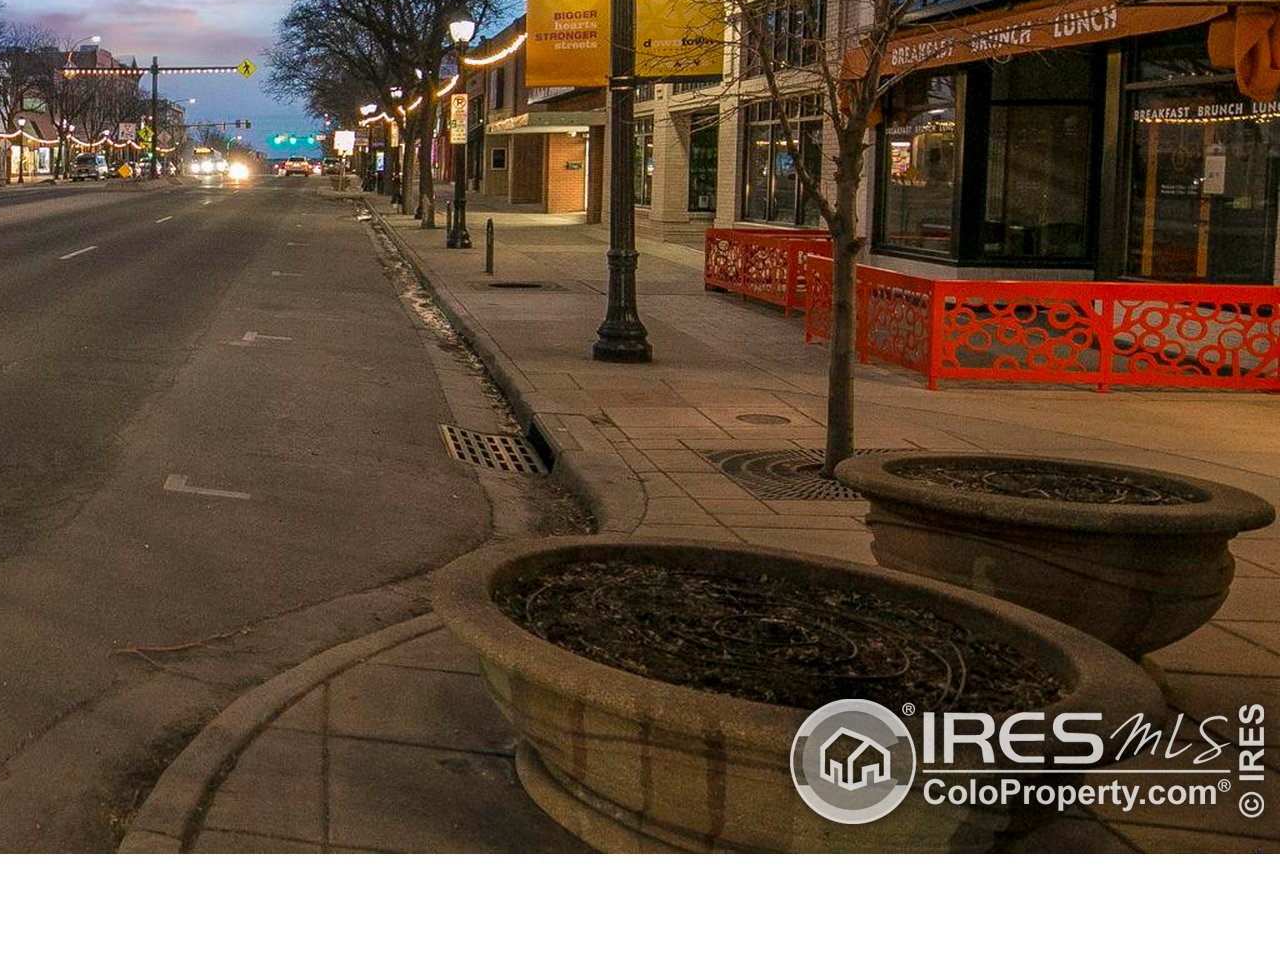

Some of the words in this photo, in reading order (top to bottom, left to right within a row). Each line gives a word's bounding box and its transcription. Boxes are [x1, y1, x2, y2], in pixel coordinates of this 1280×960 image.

[554, 10, 598, 21] BIGGER
[554, 20, 598, 30] hearts
[1054, 6, 1117, 38] LUNCH
[535, 30, 598, 41] STRONGER
[554, 40, 598, 50] streets
[1134, 106, 1190, 121] BREAKFAST
[1197, 103, 1243, 117] BRUNCH
